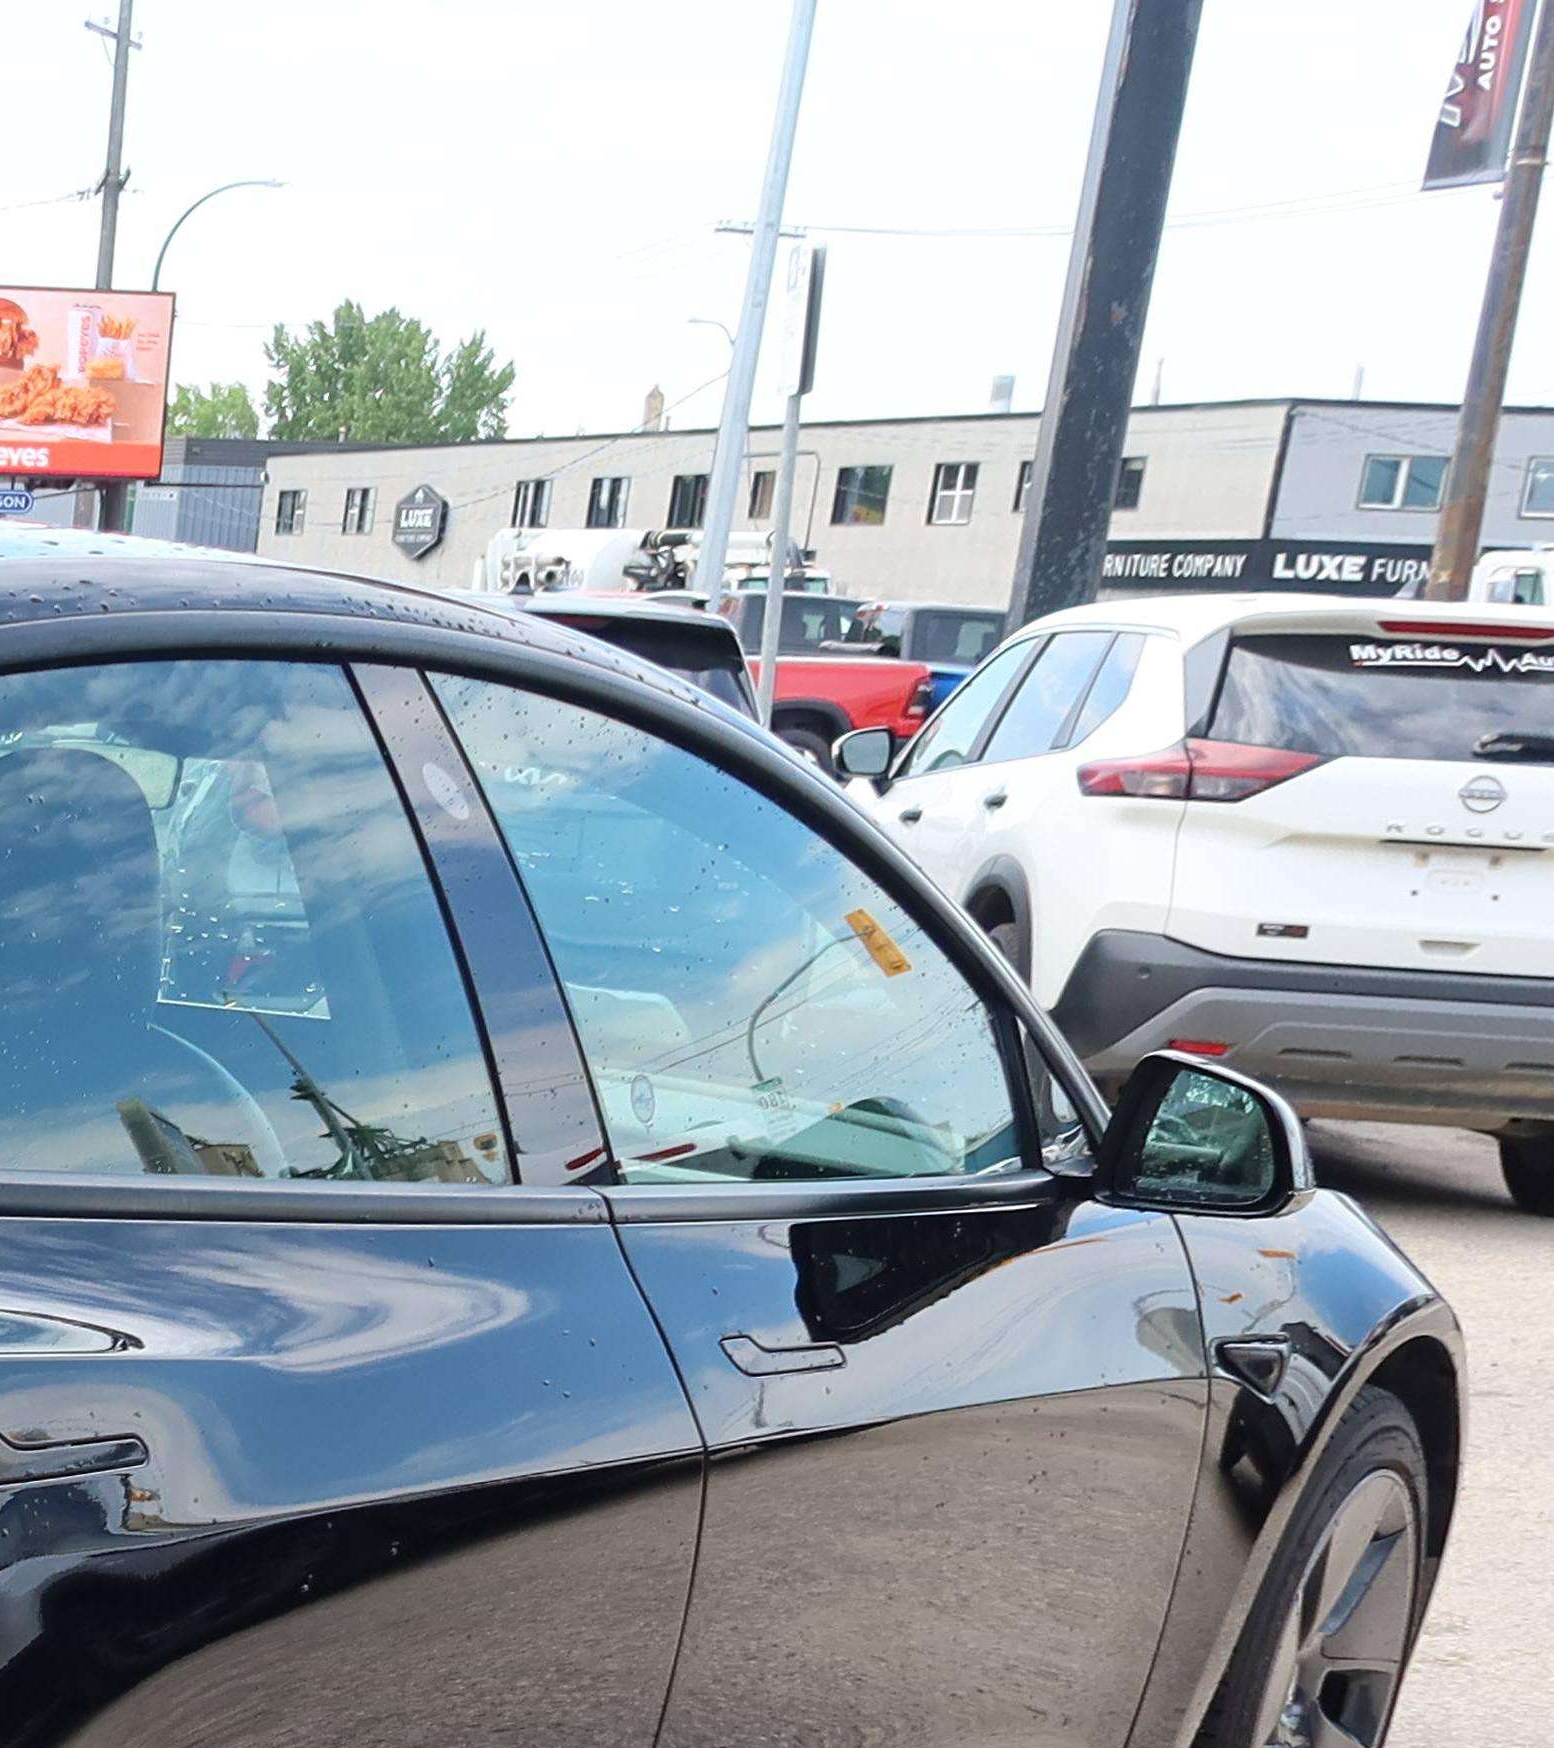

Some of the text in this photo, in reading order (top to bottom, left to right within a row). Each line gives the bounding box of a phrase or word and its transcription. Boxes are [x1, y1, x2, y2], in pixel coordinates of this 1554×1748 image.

[1476, 15, 1502, 90] AUTO
[400, 508, 434, 528] LUXE
[1172, 553, 1248, 578] COMPANY
[1272, 552, 1367, 582] LUXE
[1349, 643, 1461, 664] MyRide
